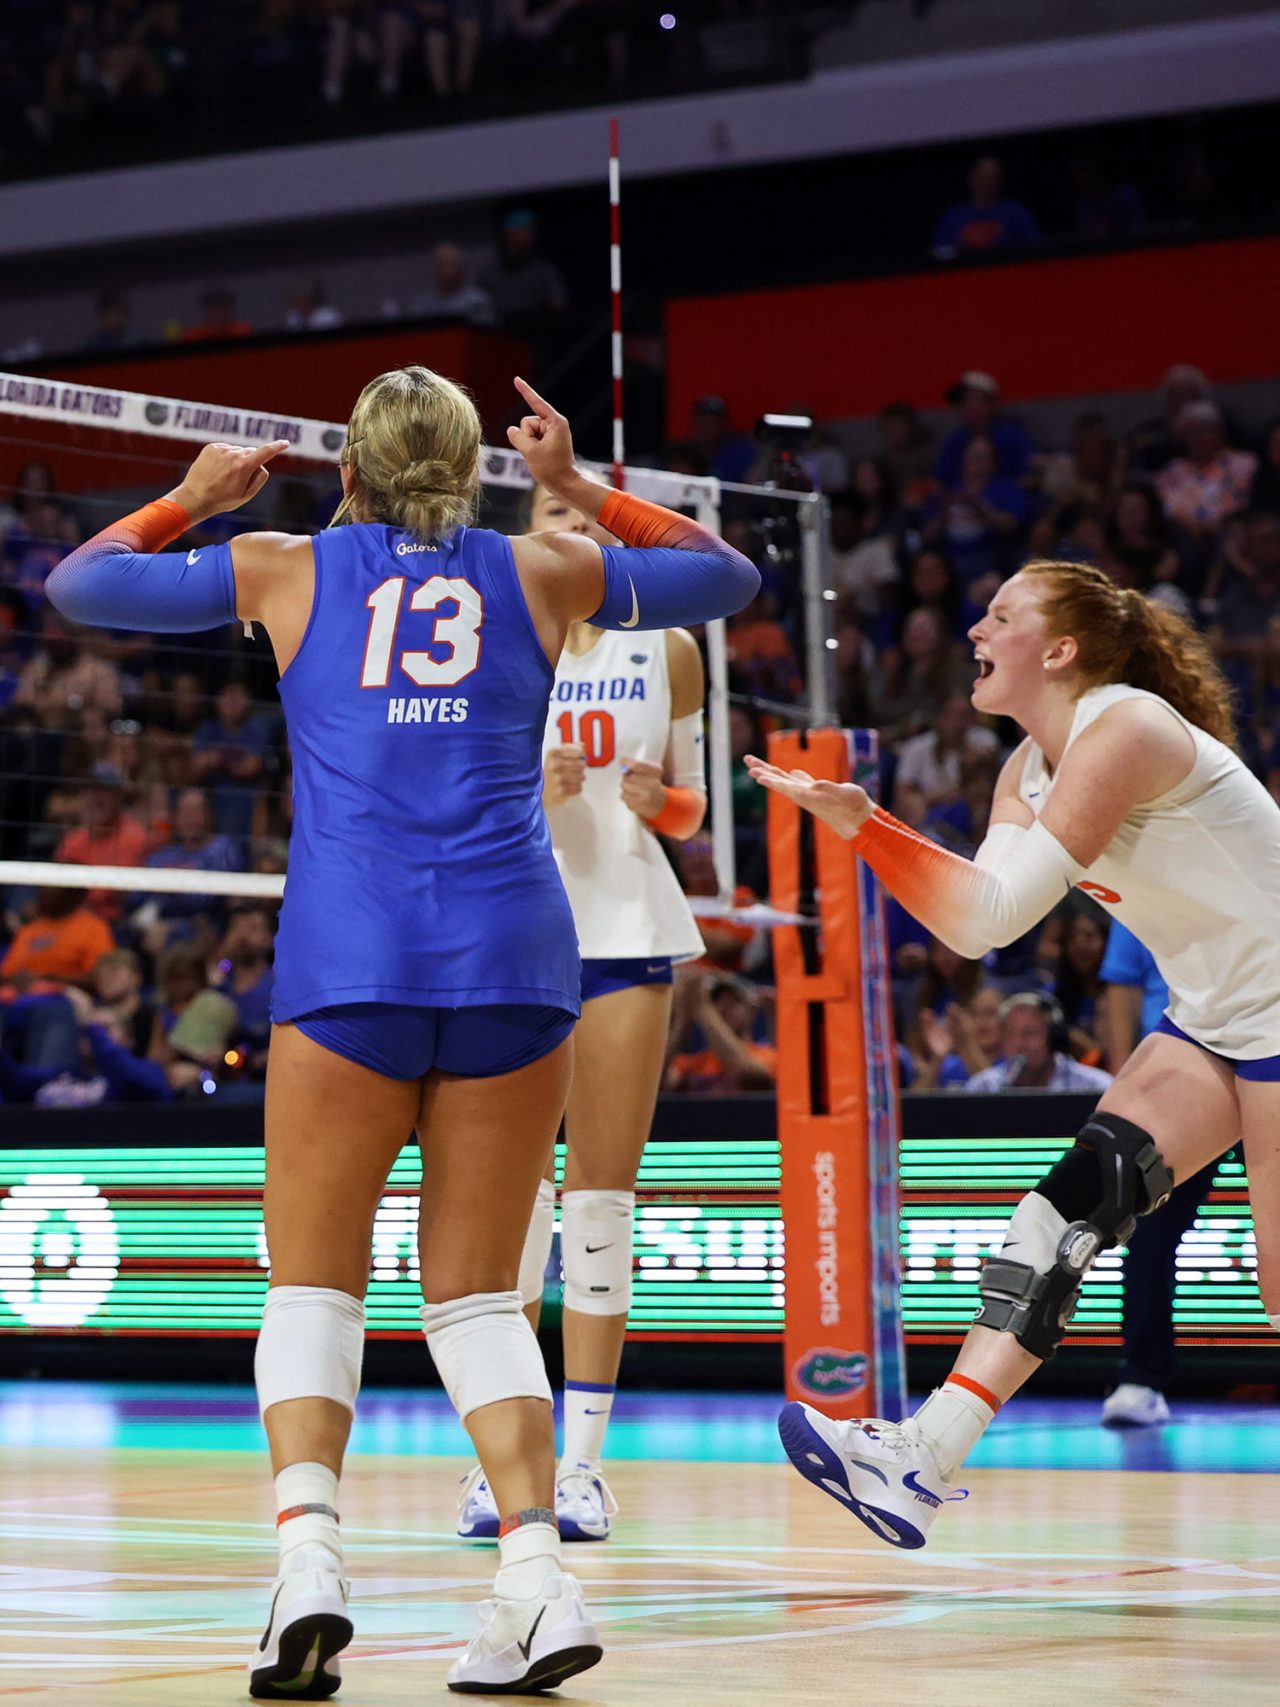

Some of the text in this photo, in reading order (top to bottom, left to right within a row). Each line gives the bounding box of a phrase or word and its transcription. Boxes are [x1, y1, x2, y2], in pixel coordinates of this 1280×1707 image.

[61, 389, 121, 417] GATORS
[396, 543, 438, 556] Gators
[360, 574, 485, 688] 13
[549, 677, 645, 702] ORIDA
[387, 698, 469, 724] HAYES
[556, 710, 615, 768] 10
[812, 1152, 840, 1326] sports imports
